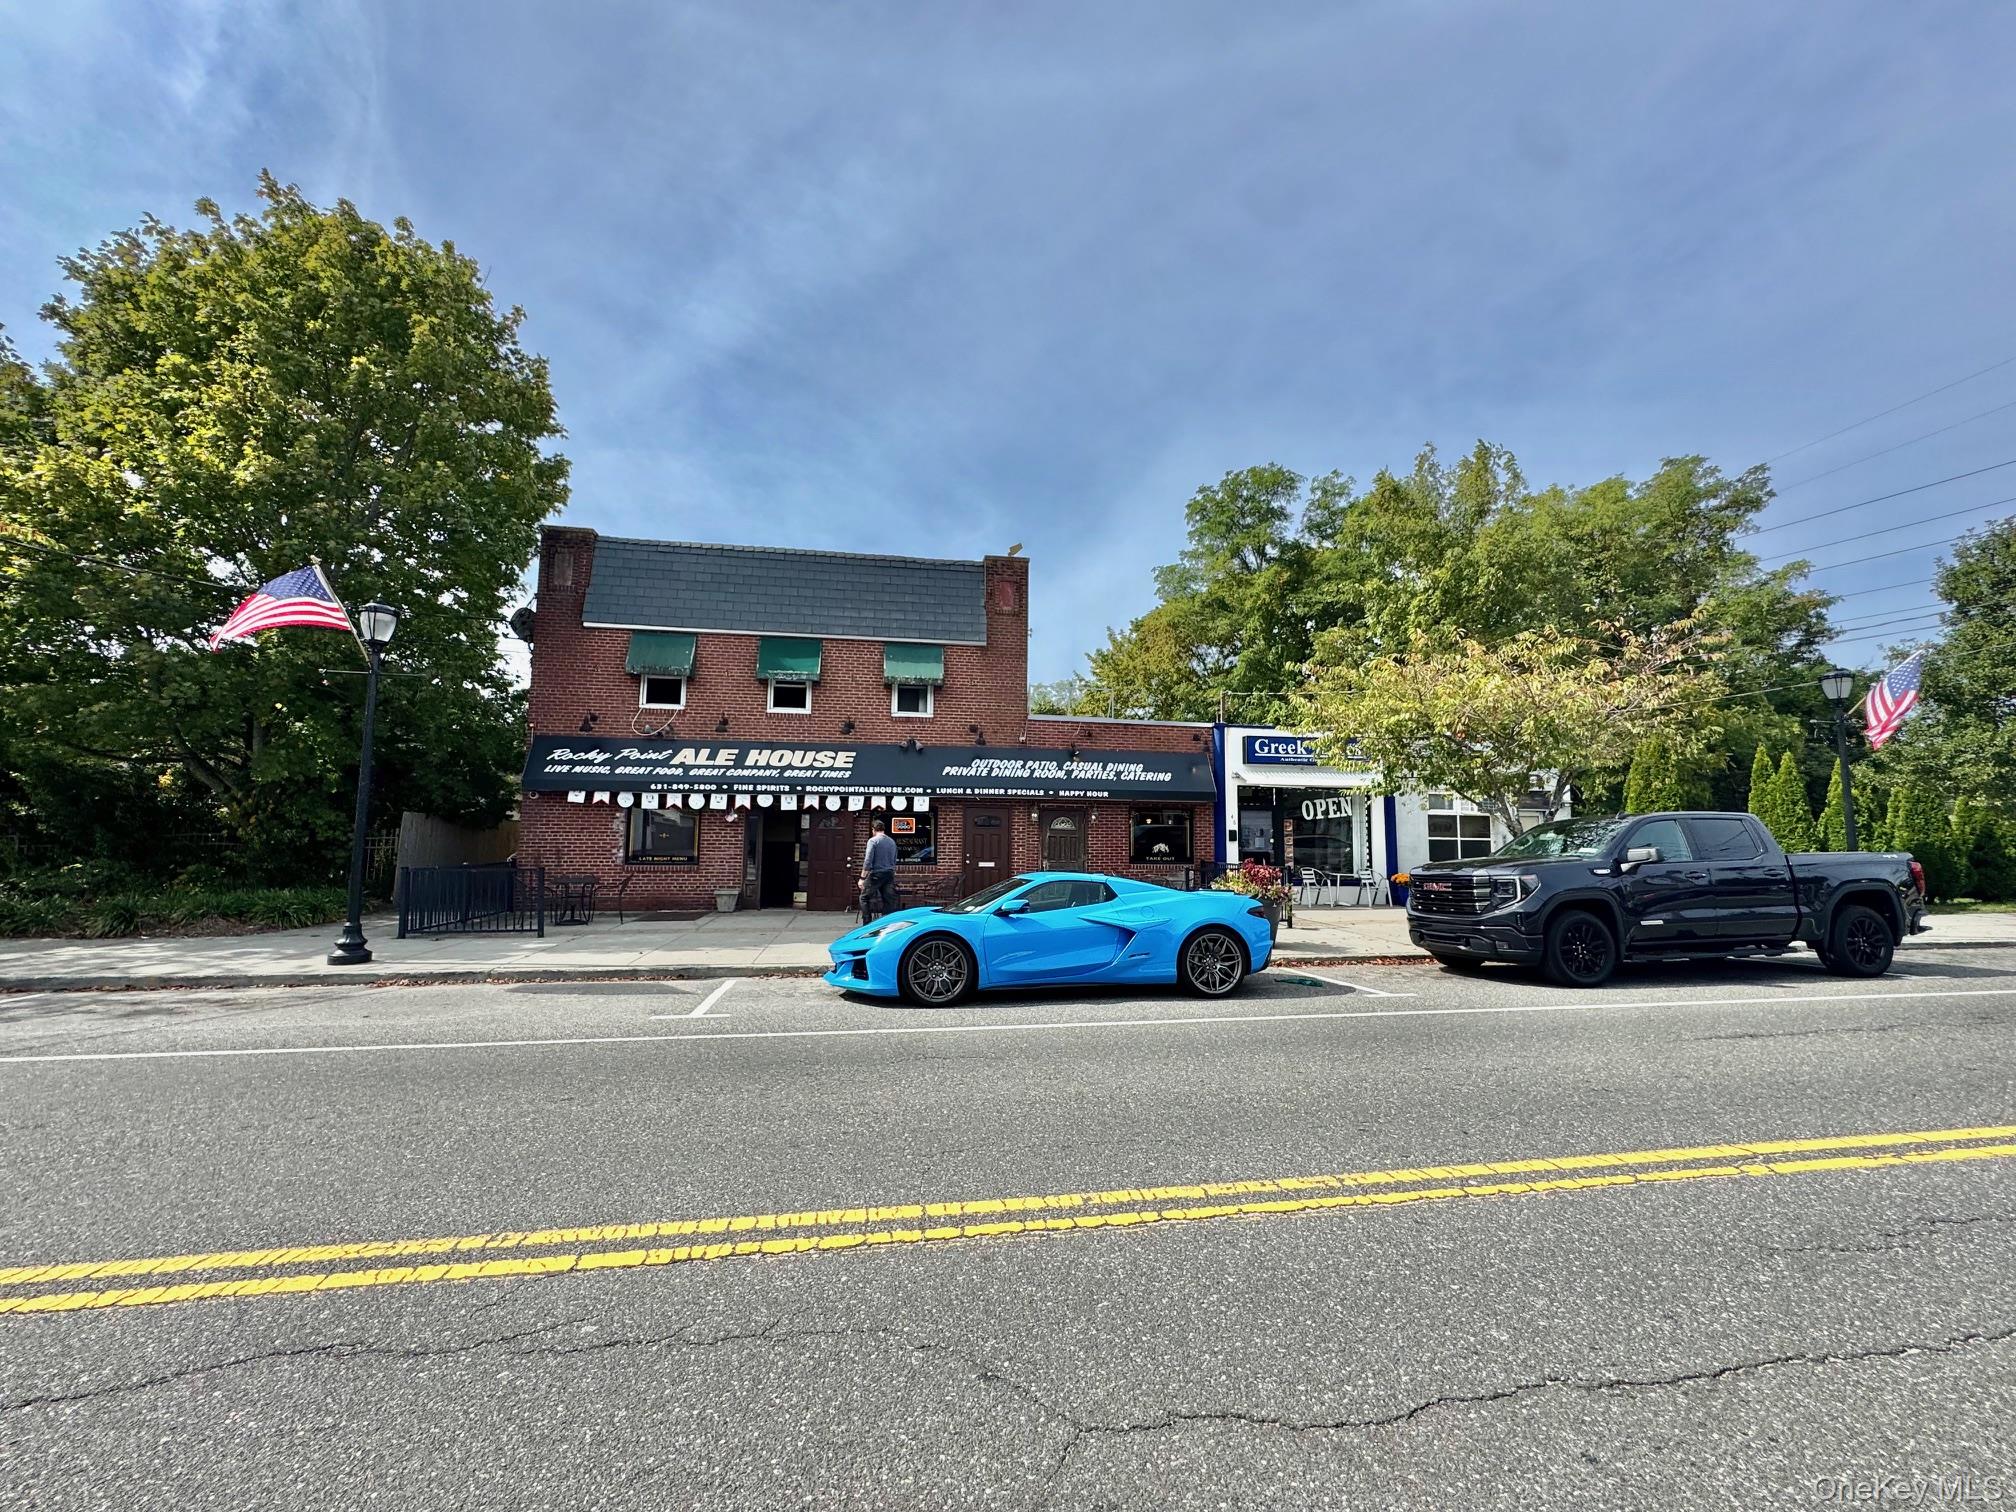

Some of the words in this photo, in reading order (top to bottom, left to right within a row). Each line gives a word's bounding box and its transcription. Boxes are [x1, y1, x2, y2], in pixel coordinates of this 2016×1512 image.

[1254, 738, 1308, 755] Greek
[546, 748, 613, 763] Rocky
[614, 748, 673, 760] Point
[669, 748, 739, 765] ALE
[744, 749, 857, 768] HOUSE
[971, 759, 1024, 769] OUTDOOR
[1025, 760, 1059, 771] PATIO,
[1063, 761, 1103, 771] CASUAL
[1106, 762, 1144, 772] DINING
[544, 765, 572, 773] LIVE
[571, 765, 611, 774] MUSIC,
[614, 766, 653, 775] GREAT
[652, 767, 684, 776] FOOD,
[689, 768, 726, 776] GREAT
[726, 768, 780, 778] COMPANY,
[783, 769, 816, 778] GREAT
[819, 770, 852, 778] TIMES
[942, 766, 990, 777] PRIVATE
[991, 767, 1031, 778] DINING
[1033, 769, 1068, 780] ROOM,
[1071, 770, 1117, 781] PARTIES,
[1120, 771, 1172, 782] CATERING
[805, 785, 924, 794] ROCKYPOINTALEHOUSE.COM
[1007, 788, 1045, 796] SPECIALS
[1301, 796, 1353, 820] OPEN
